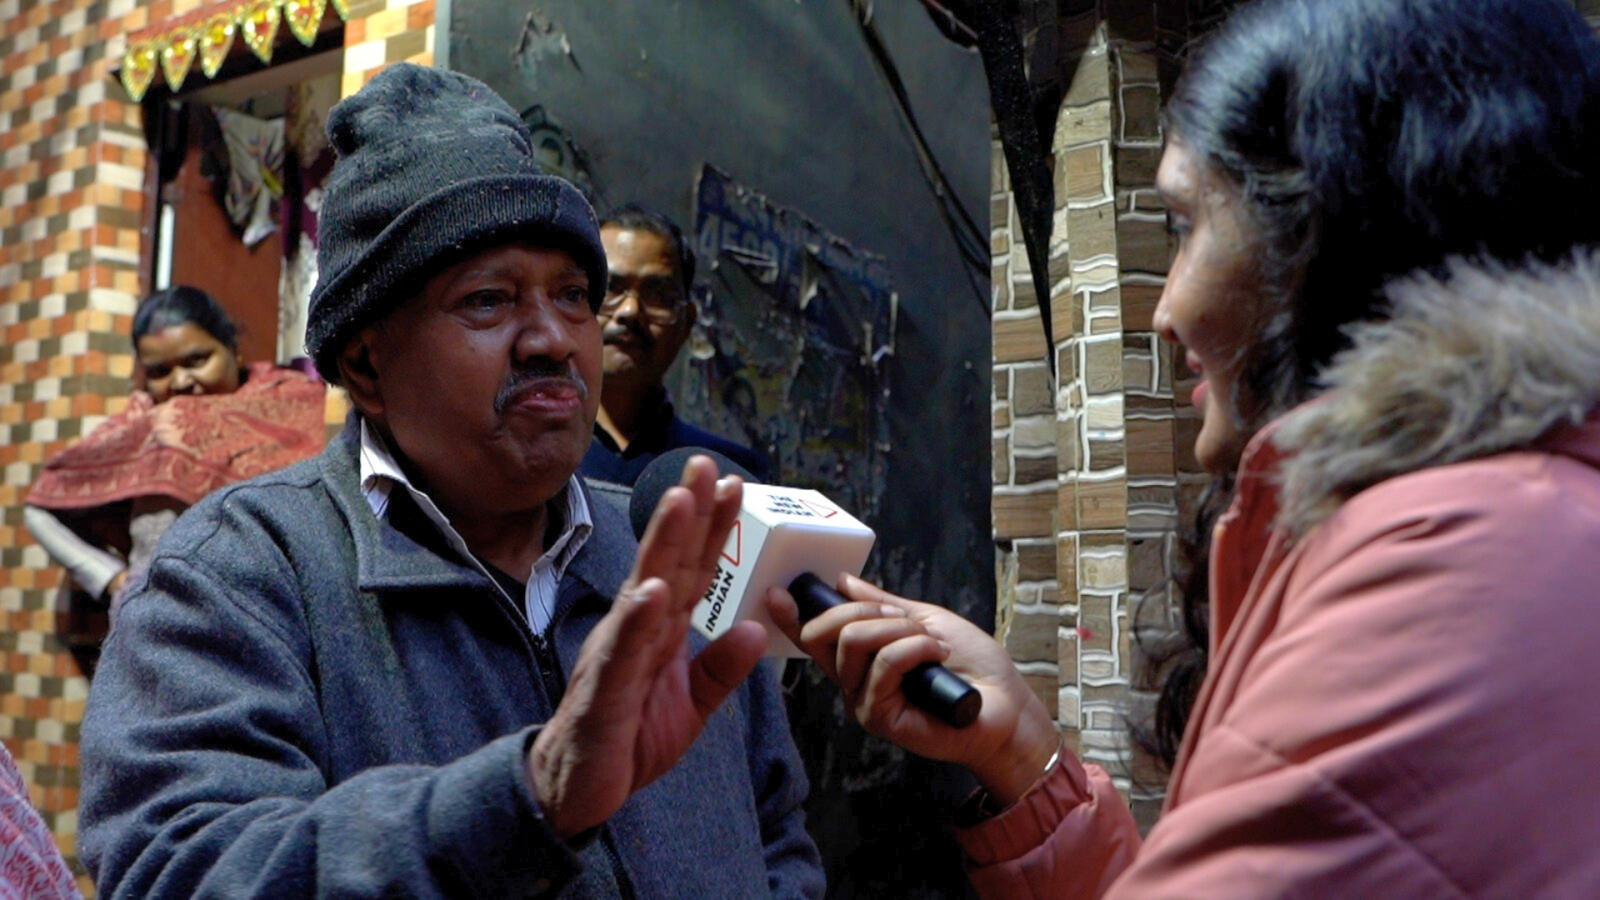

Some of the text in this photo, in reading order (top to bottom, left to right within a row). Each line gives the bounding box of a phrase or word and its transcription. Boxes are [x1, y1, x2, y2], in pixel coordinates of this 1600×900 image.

[767, 494, 794, 503] THE
[773, 502, 804, 510] NEW
[767, 507, 815, 517] INDIAN
[705, 570, 734, 633] INDIAN
